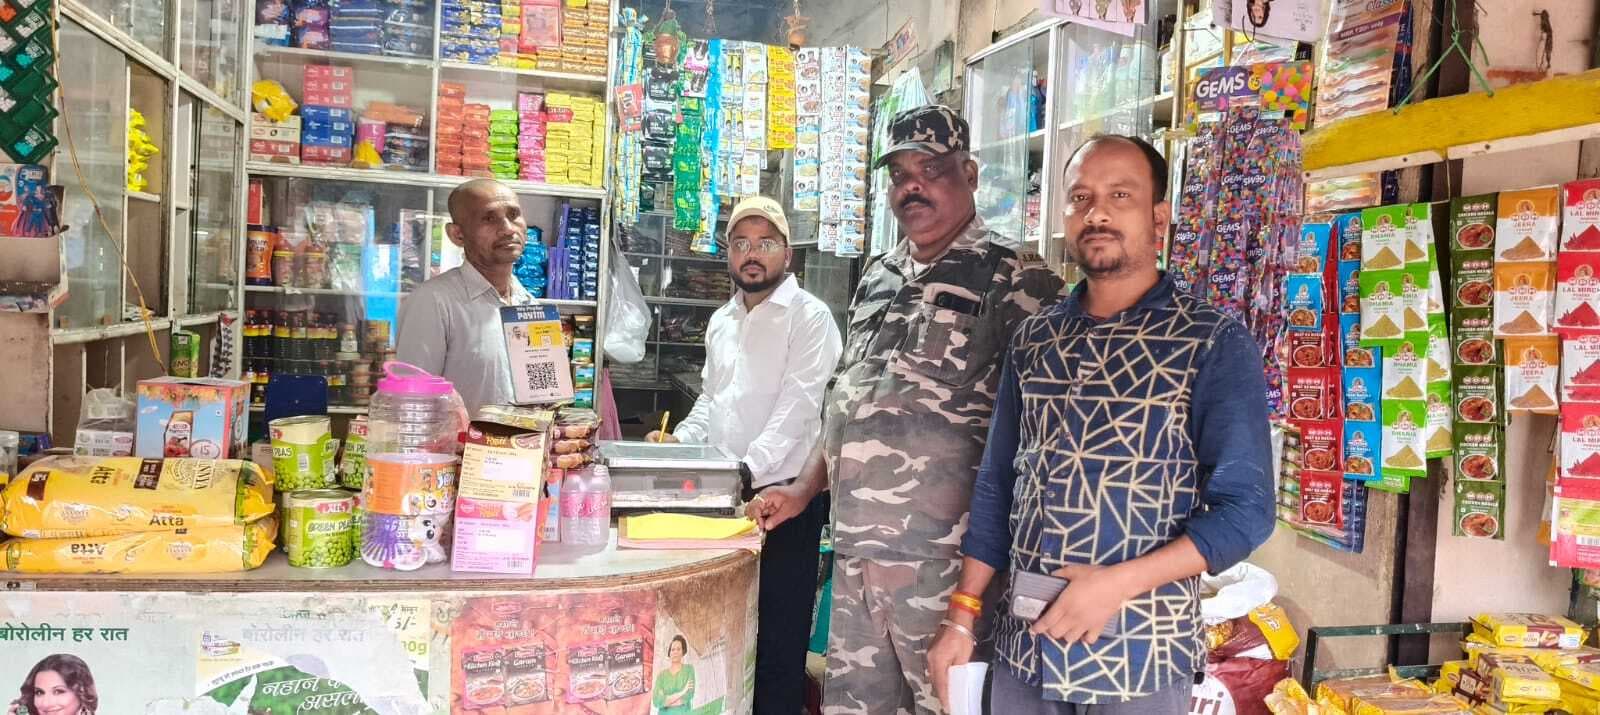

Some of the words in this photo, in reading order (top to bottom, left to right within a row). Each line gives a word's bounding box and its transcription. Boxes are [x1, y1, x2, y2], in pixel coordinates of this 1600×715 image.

[1196, 72, 1246, 98] GEMS
[1230, 122, 1252, 134] GEMS
[1224, 174, 1244, 184] GEM
[1243, 175, 1265, 186] GEMS
[1217, 222, 1241, 233] GEMS
[1176, 232, 1197, 241] GEMS
[1212, 272, 1236, 283] GEMS
[149, 514, 184, 526] Atta
[72, 628, 94, 642] हर
[100, 628, 130, 641] रात
